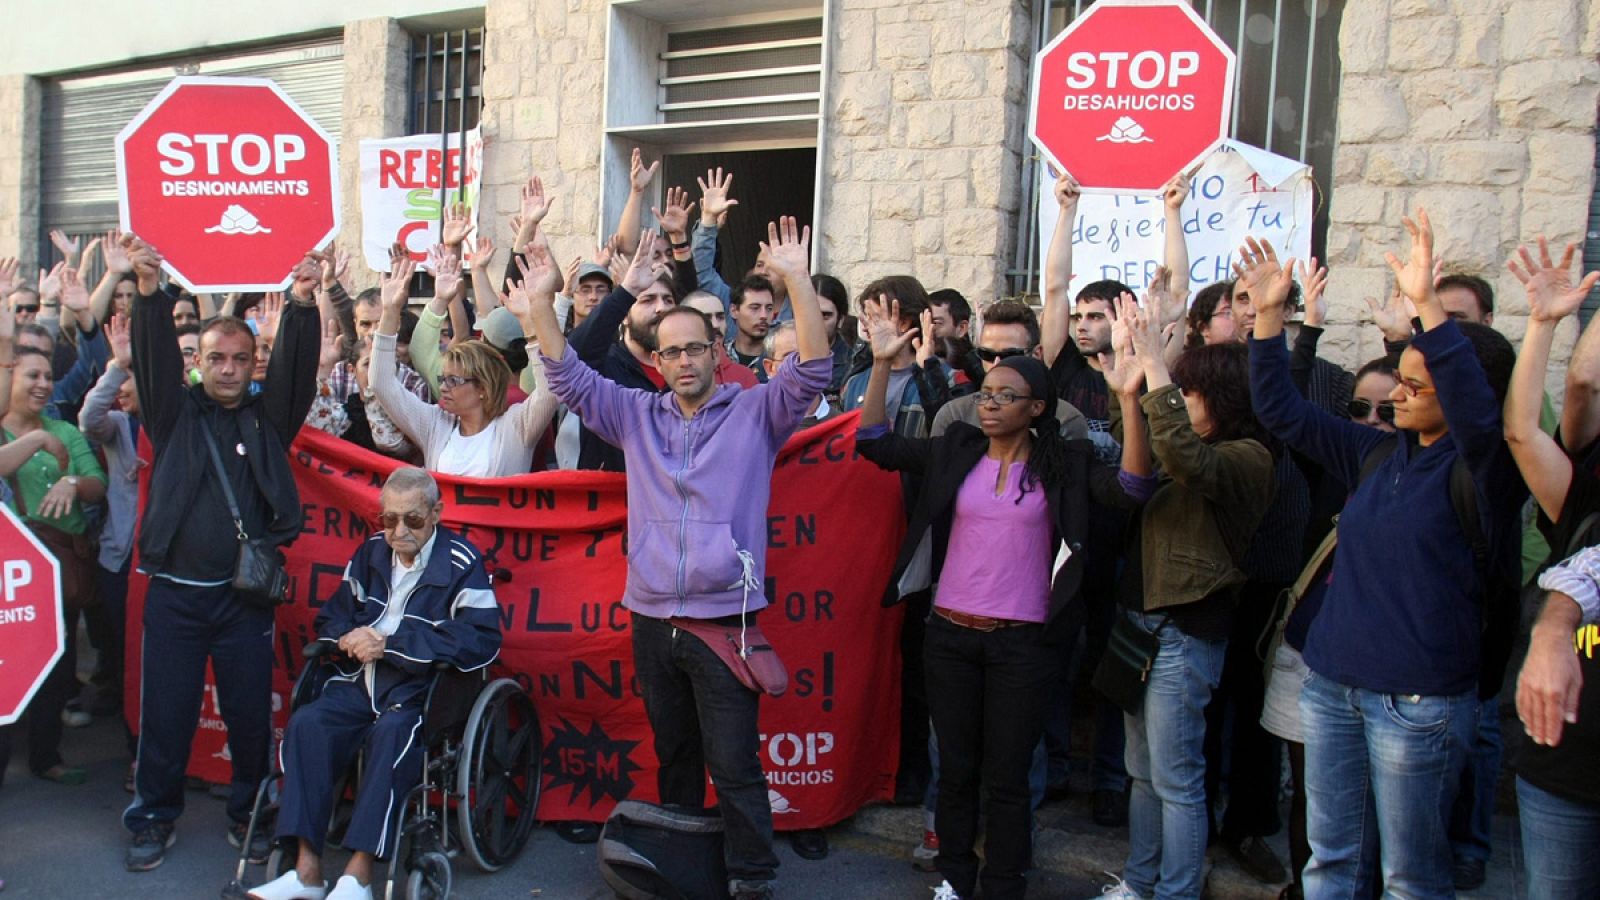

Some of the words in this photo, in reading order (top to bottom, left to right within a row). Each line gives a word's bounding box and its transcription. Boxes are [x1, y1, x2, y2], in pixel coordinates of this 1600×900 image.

[1066, 51, 1200, 89] STOP
[1064, 94, 1195, 110] DESAHUCIOS
[156, 132, 306, 176] STOP
[161, 180, 309, 196] DESNONAMENTS
[559, 748, 619, 781] 15-M
